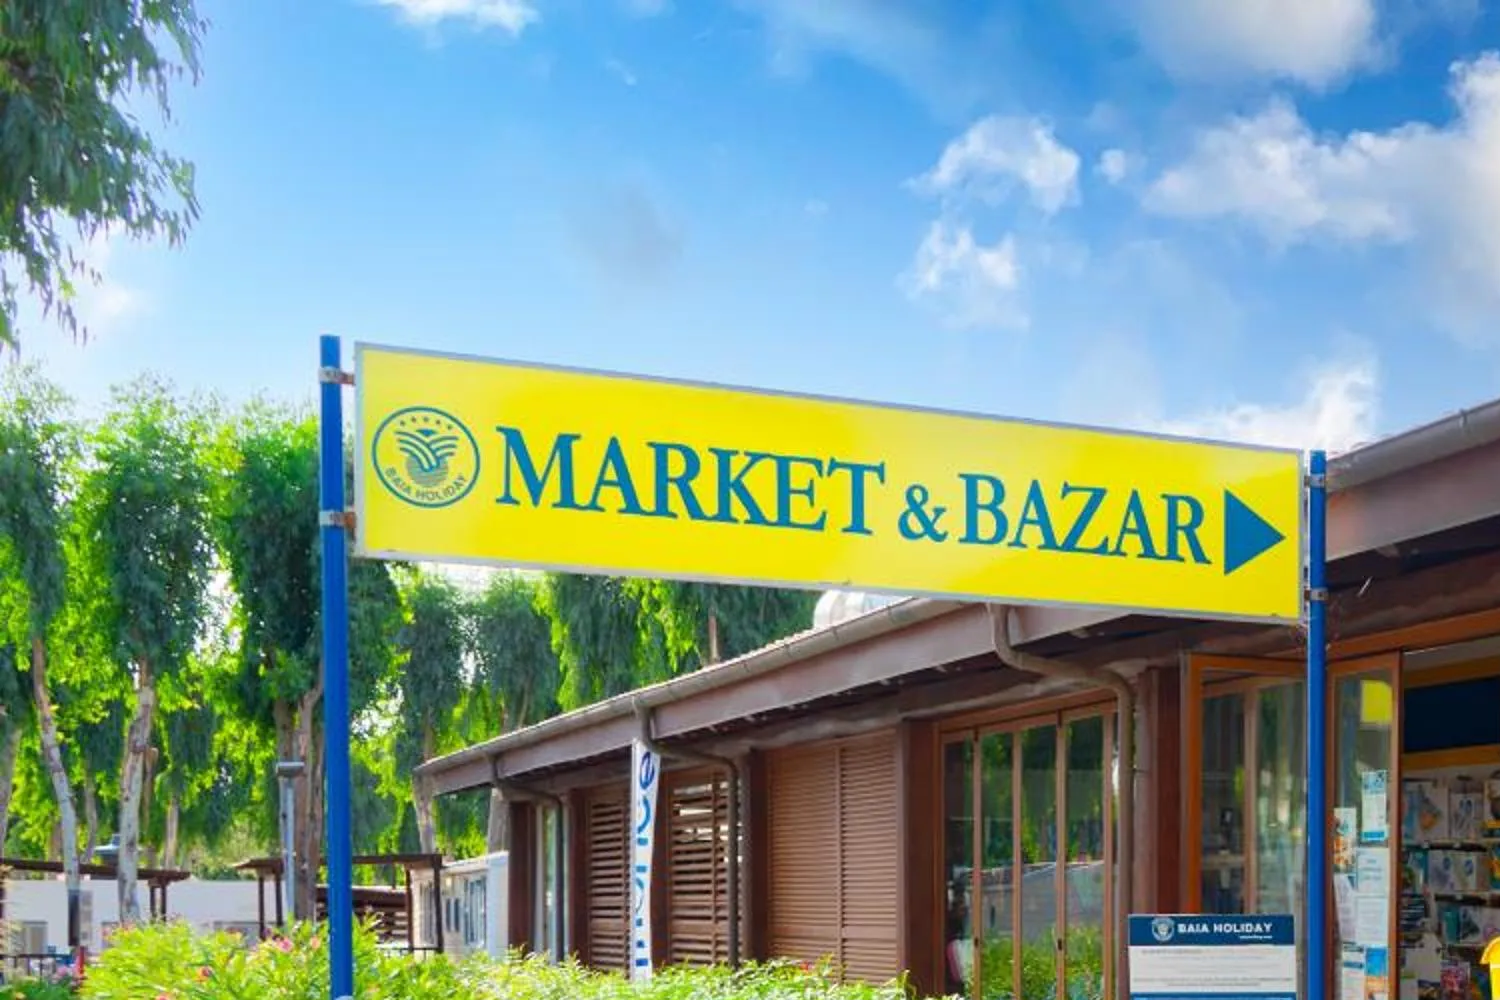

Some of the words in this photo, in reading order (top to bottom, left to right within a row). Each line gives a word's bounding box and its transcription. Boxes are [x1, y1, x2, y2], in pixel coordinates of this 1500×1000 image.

[496, 425, 886, 536] MARKET
[897, 482, 949, 544] &
[957, 472, 1213, 566] BAZAR
[1177, 922, 1210, 934] BAIA
[1213, 922, 1273, 934] HOLIDAY
